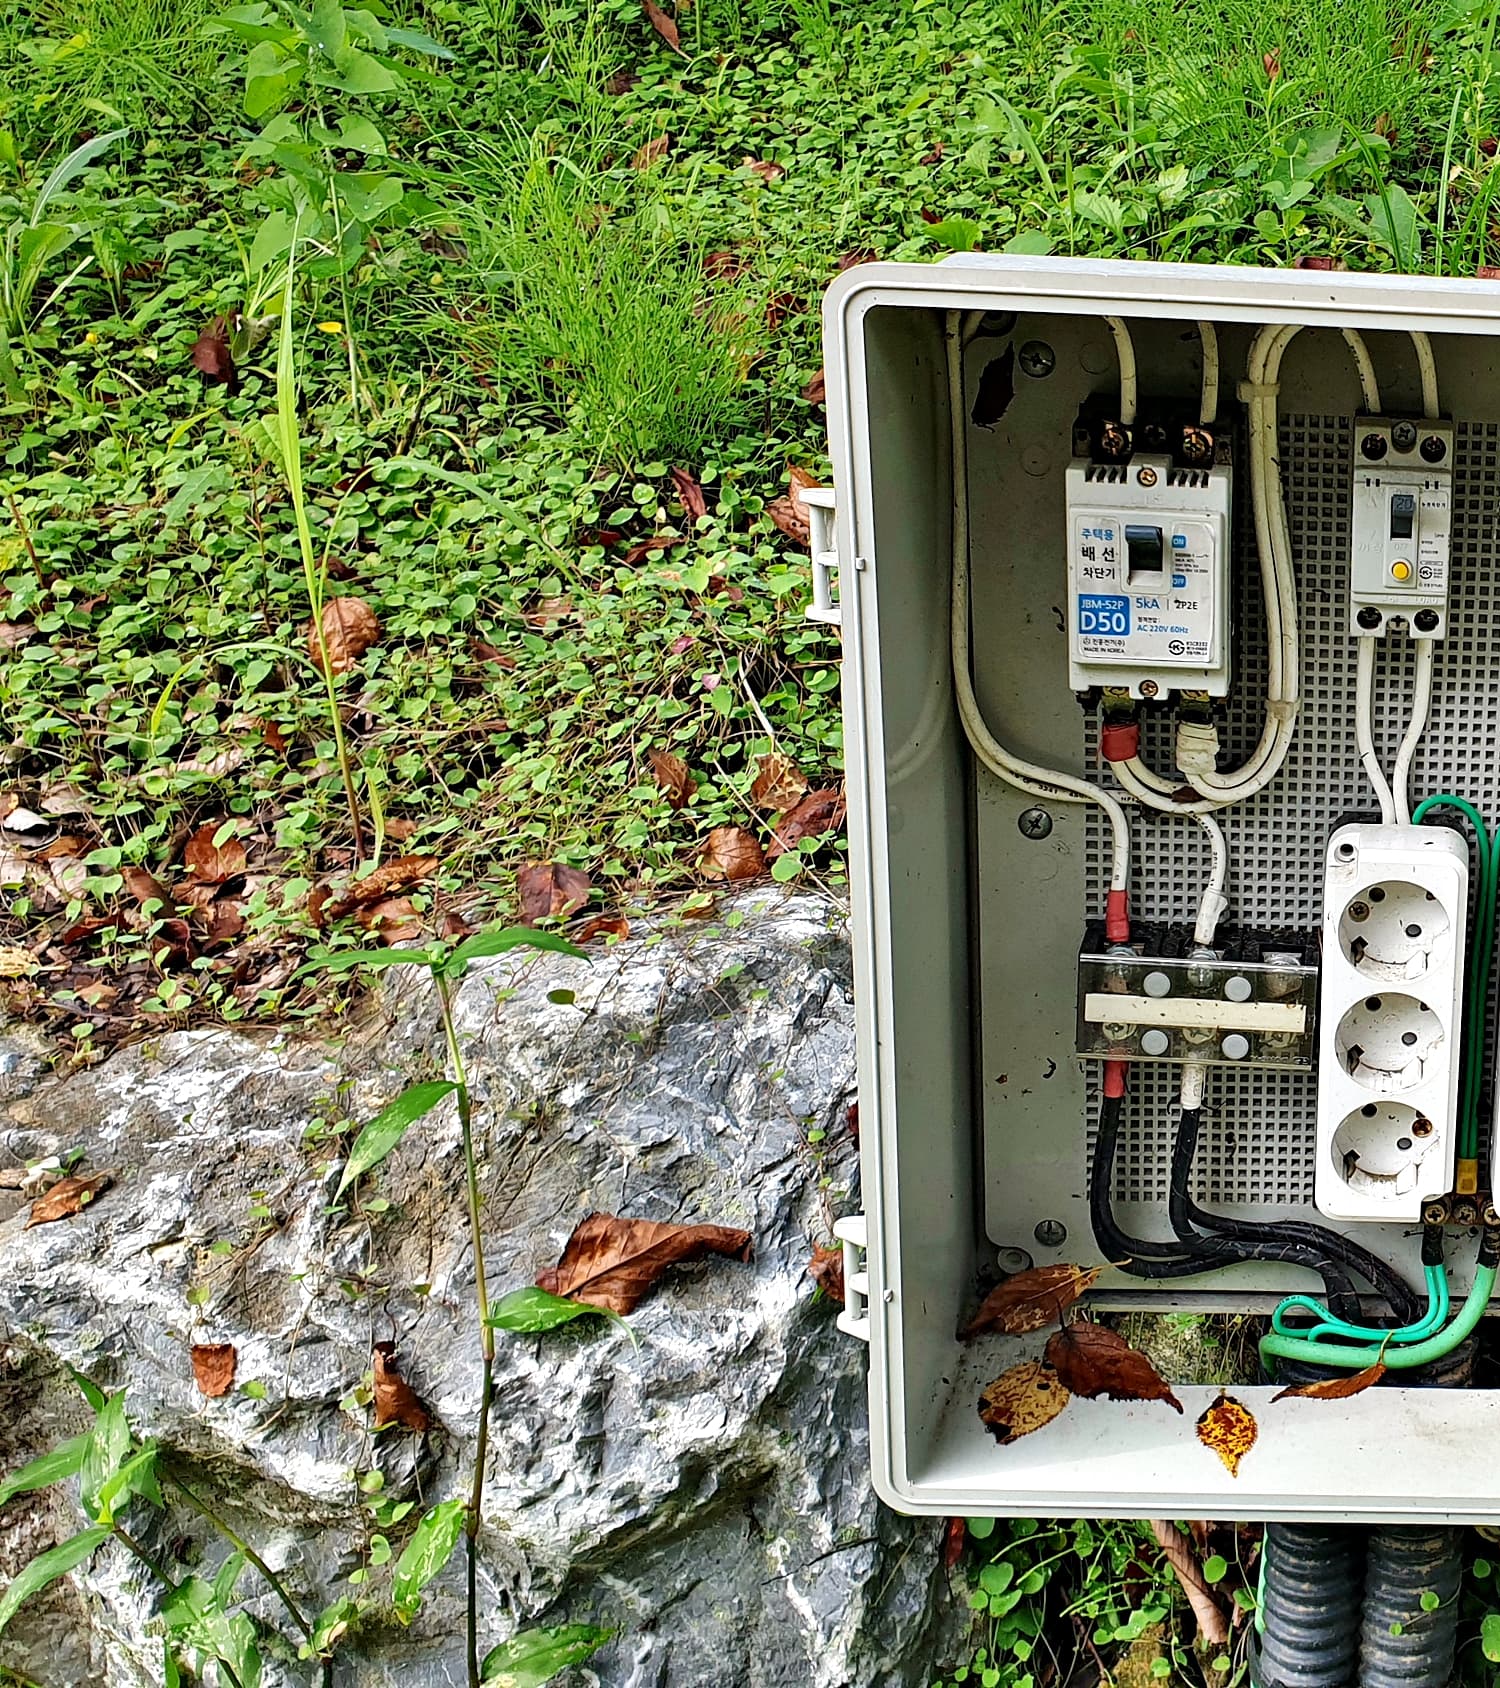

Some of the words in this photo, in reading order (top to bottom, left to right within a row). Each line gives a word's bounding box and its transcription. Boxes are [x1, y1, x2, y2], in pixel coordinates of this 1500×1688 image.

[1081, 528, 1114, 541] 주택용
[1083, 567, 1115, 580] 차단기
[1081, 599, 1124, 610] JBM-52P
[1136, 597, 1160, 609] 5kA
[1081, 611, 1126, 633] D50
[1150, 625, 1169, 633] 220V
